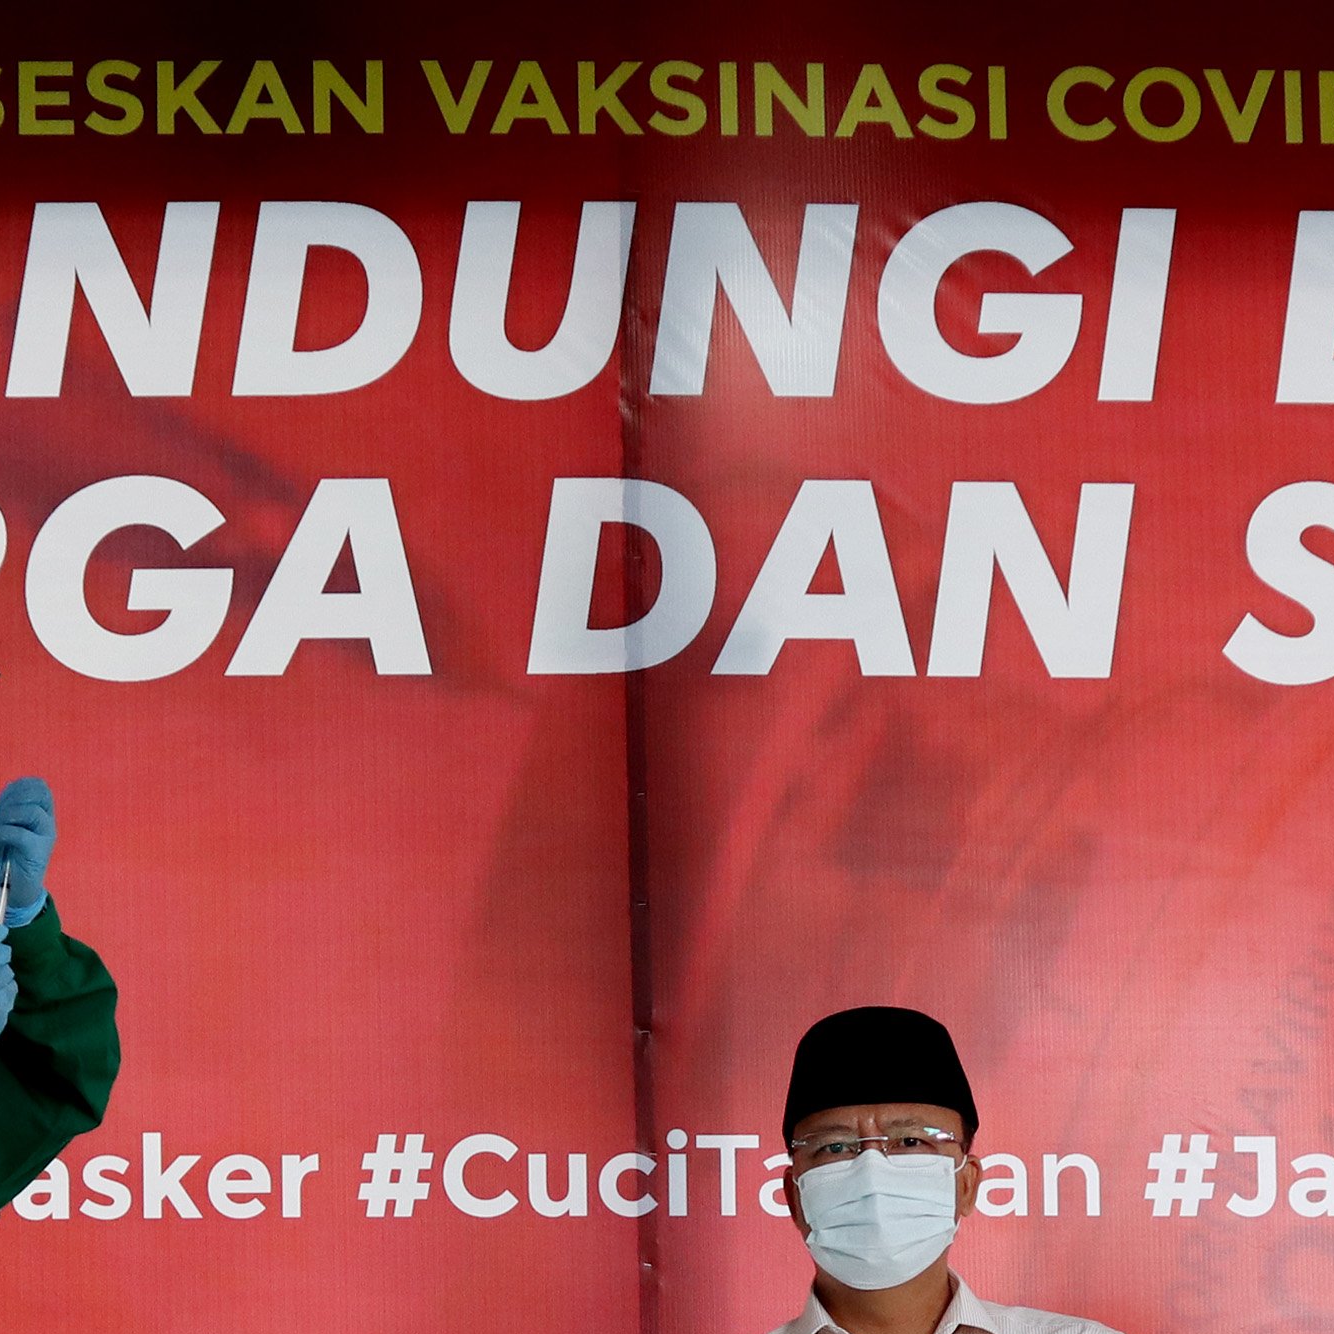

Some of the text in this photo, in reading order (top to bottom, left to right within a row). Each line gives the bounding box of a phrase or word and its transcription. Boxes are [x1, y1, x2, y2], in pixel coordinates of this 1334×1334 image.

[431, 62, 1007, 139] VAKSINASI
[525, 476, 1137, 680] DAN
[358, 1129, 1101, 1218] #CuciTaan
